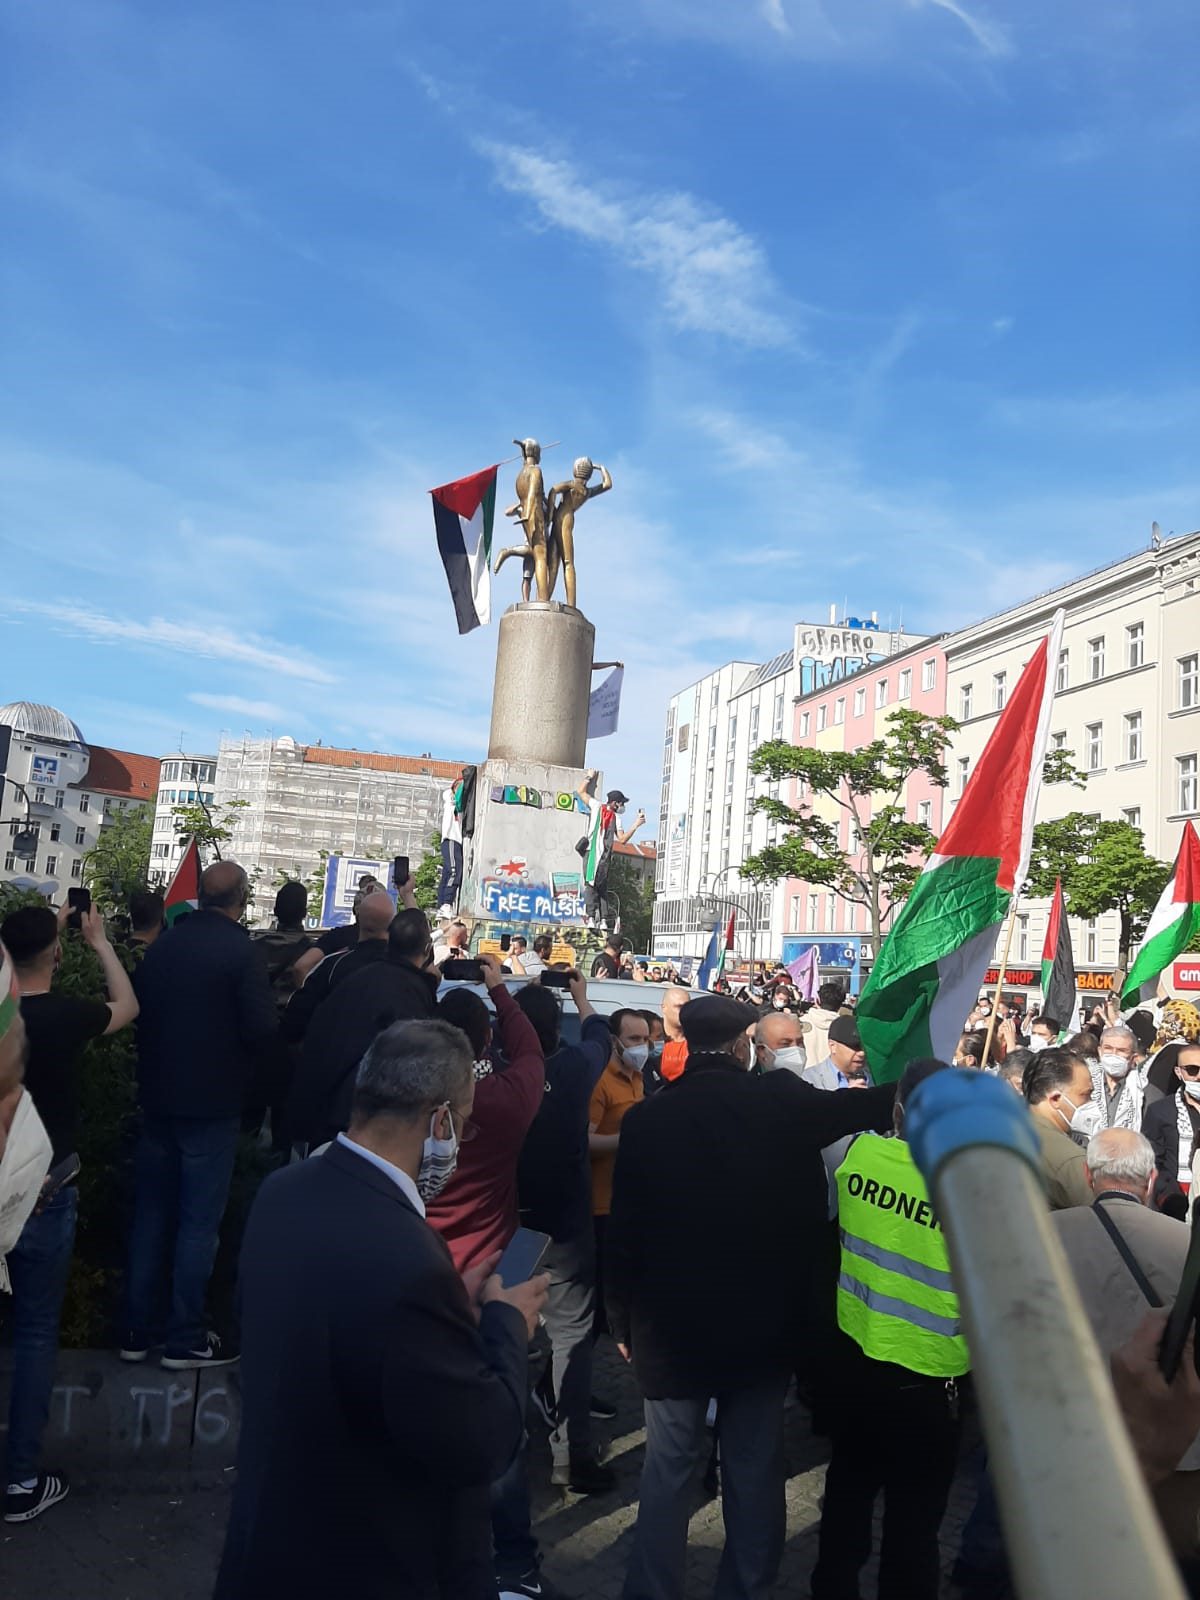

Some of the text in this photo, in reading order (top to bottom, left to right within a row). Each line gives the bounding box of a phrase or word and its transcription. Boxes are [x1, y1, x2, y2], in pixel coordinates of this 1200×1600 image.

[32, 773, 54, 784] Bank
[483, 885, 531, 913] FREE
[308, 918, 318, 929] U
